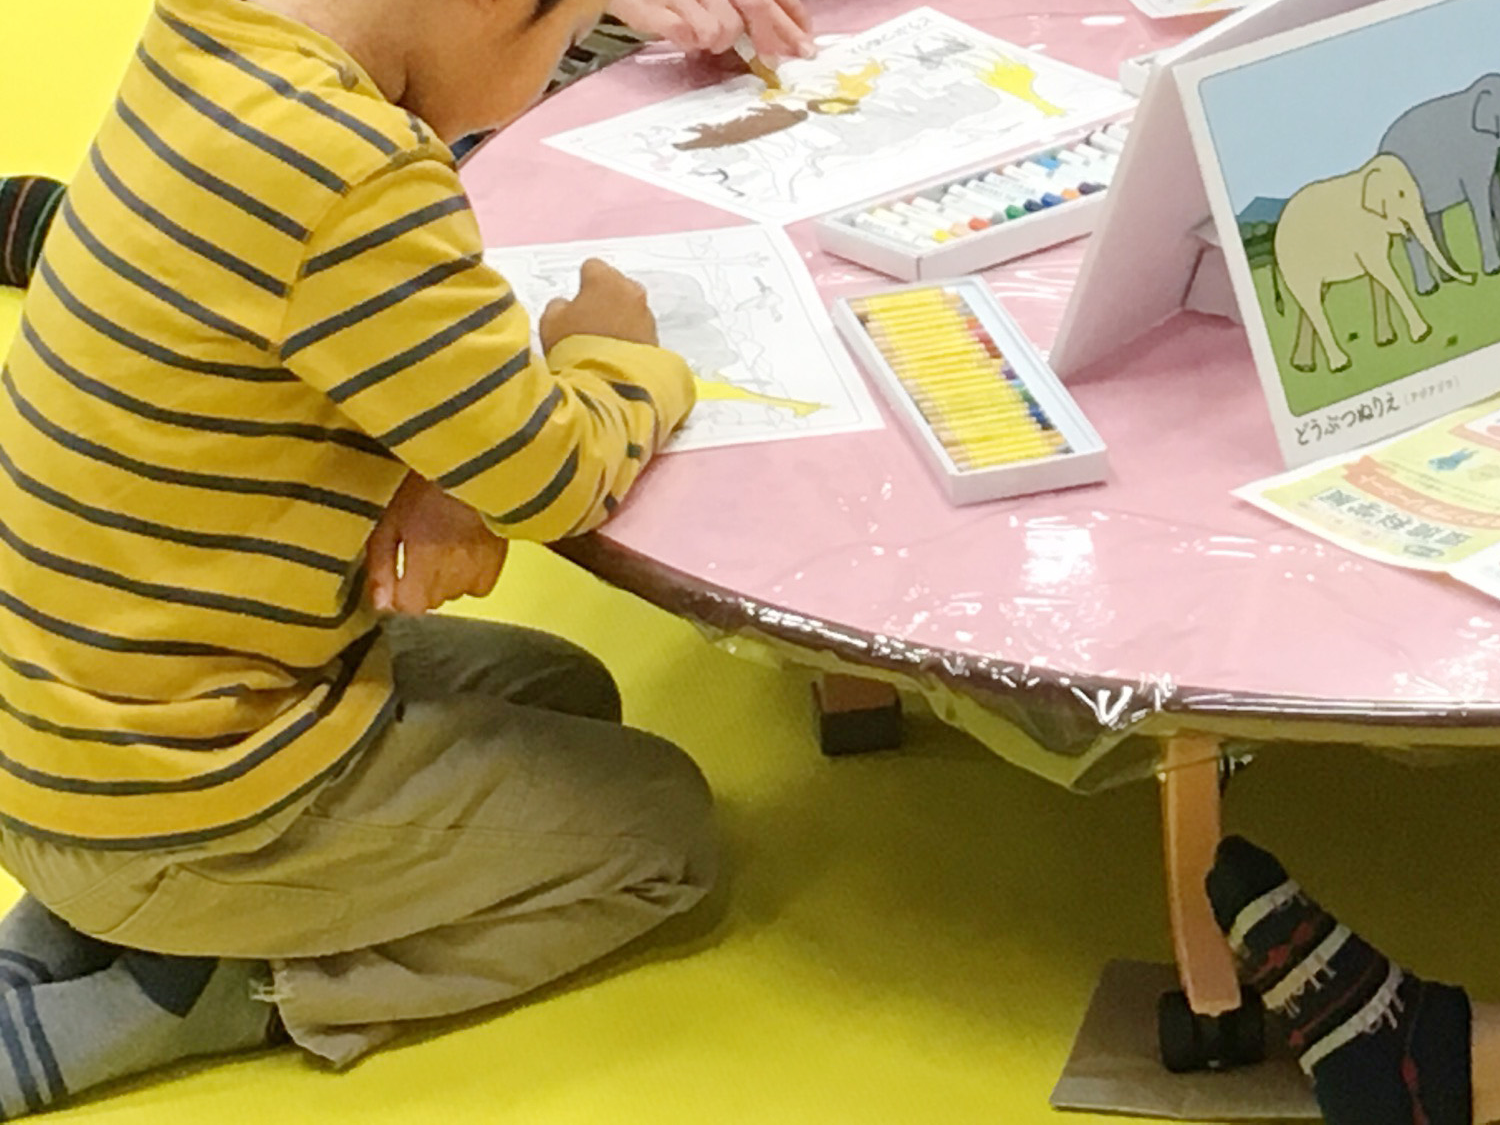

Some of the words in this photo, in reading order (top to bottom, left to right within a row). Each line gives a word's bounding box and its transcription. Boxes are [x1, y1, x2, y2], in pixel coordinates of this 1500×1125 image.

[1294, 392, 1400, 446] どうぶつぬりえ
